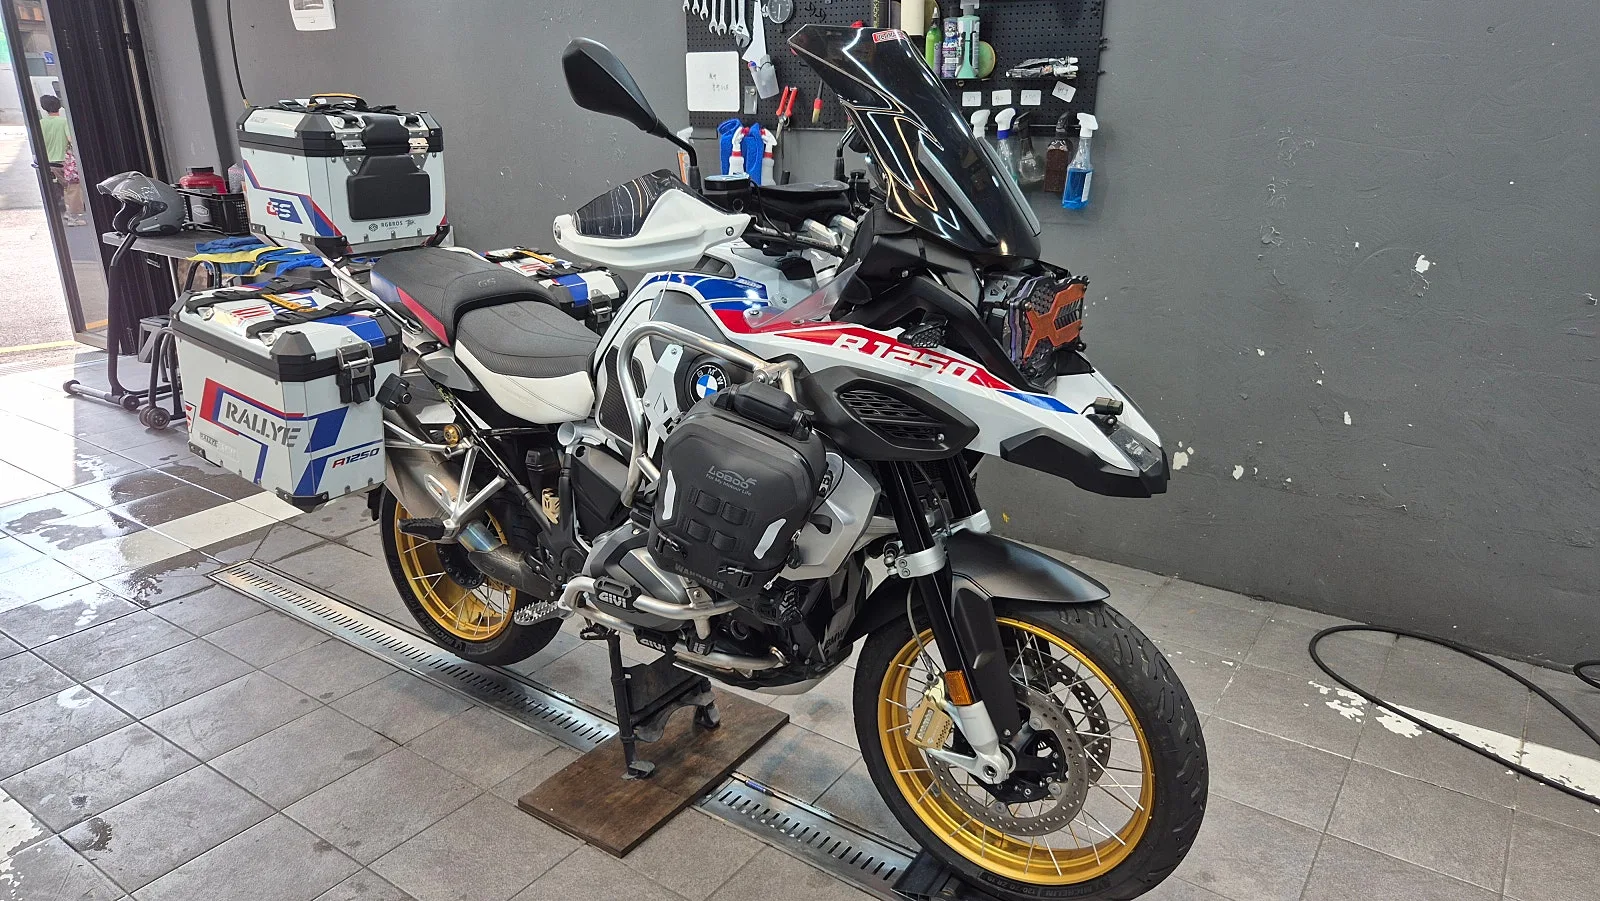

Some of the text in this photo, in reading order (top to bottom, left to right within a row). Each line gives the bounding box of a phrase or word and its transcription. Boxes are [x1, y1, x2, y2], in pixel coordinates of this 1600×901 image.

[225, 401, 302, 448] RALLYE
[332, 447, 380, 469] R1250
[598, 592, 627, 609] GIVI
